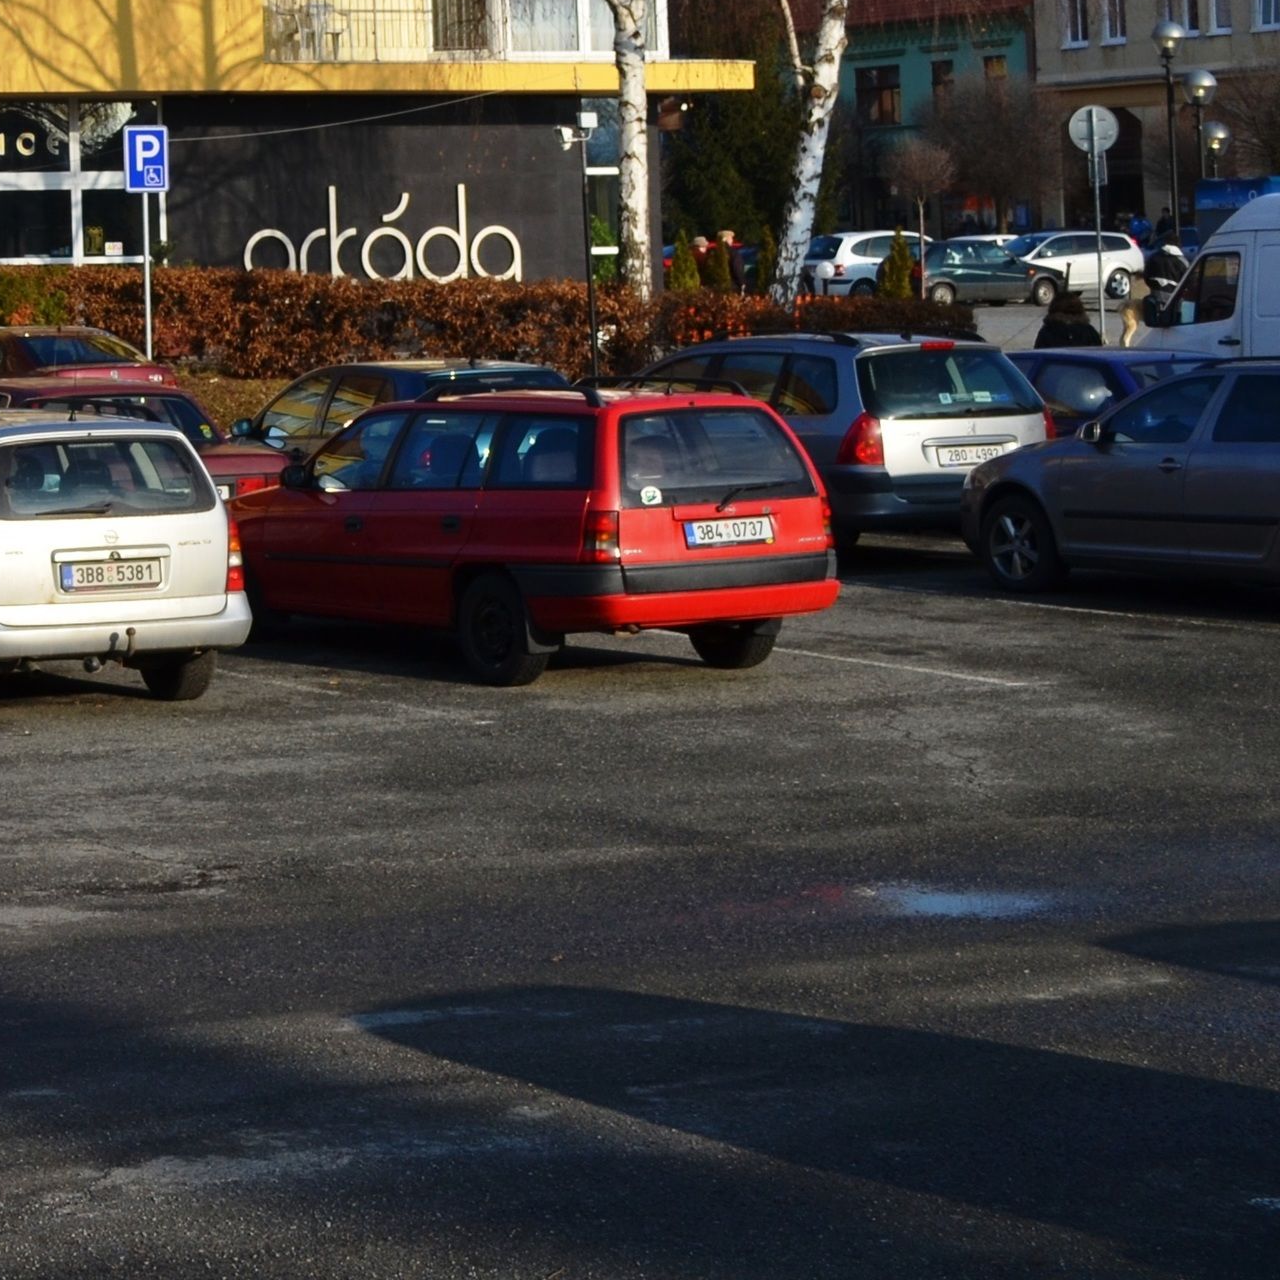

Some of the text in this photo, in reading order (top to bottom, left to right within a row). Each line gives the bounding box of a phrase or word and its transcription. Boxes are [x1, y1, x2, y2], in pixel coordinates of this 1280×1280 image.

[135, 134, 161, 172] P
[243, 183, 522, 284] arkáda
[697, 520, 764, 541] 3B4 0737
[76, 563, 154, 584] 3B8 5381
